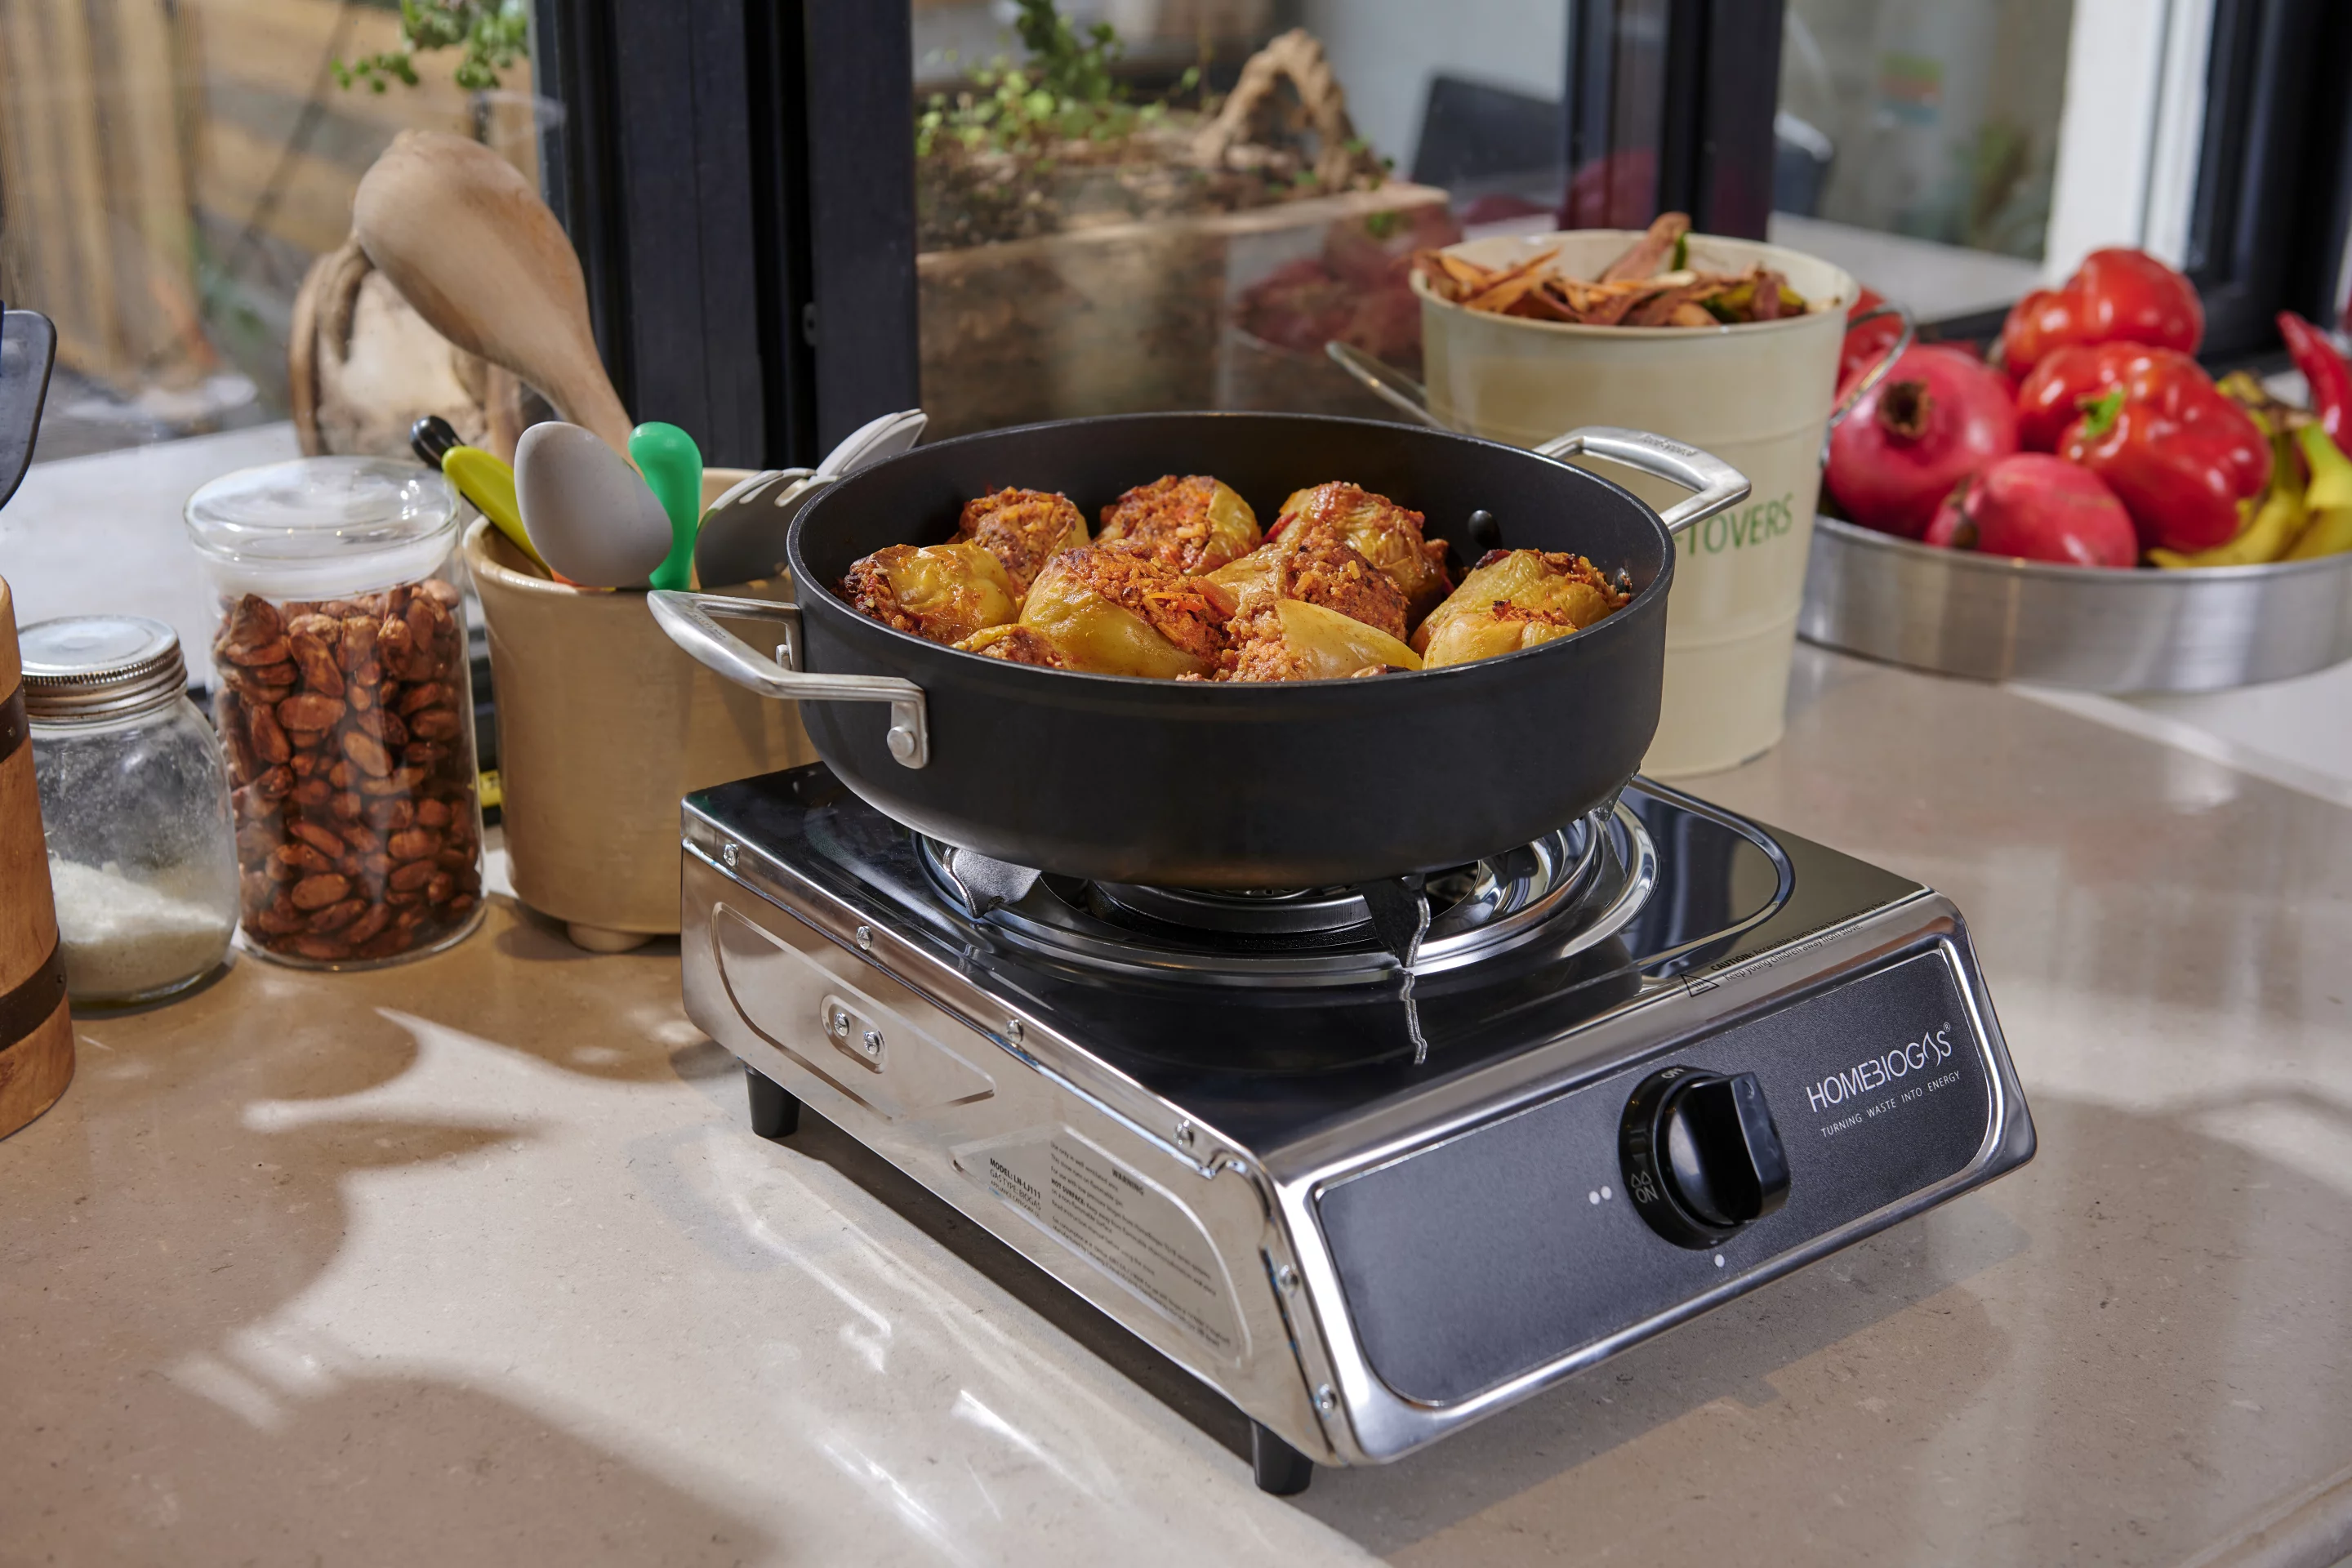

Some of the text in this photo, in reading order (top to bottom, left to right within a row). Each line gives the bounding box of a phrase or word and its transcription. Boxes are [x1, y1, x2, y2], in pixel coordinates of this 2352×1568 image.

[1710, 952, 1755, 971] CAUTION:
[1753, 936, 1793, 956] Accessible
[1793, 929, 1813, 941] parts
[1812, 921, 1830, 933] may
[1829, 912, 1860, 926] become
[1859, 905, 1877, 915] very
[1722, 923, 1864, 981] Keep young children away from stove.
[1820, 1070, 1960, 1138] TURNING WASTE INTO ENERGY
[990, 1157, 1013, 1180] MODEL:
[990, 1169, 1041, 1211] GAS TYPE: BIOGAS
[1635, 1185, 1659, 1204] ON
